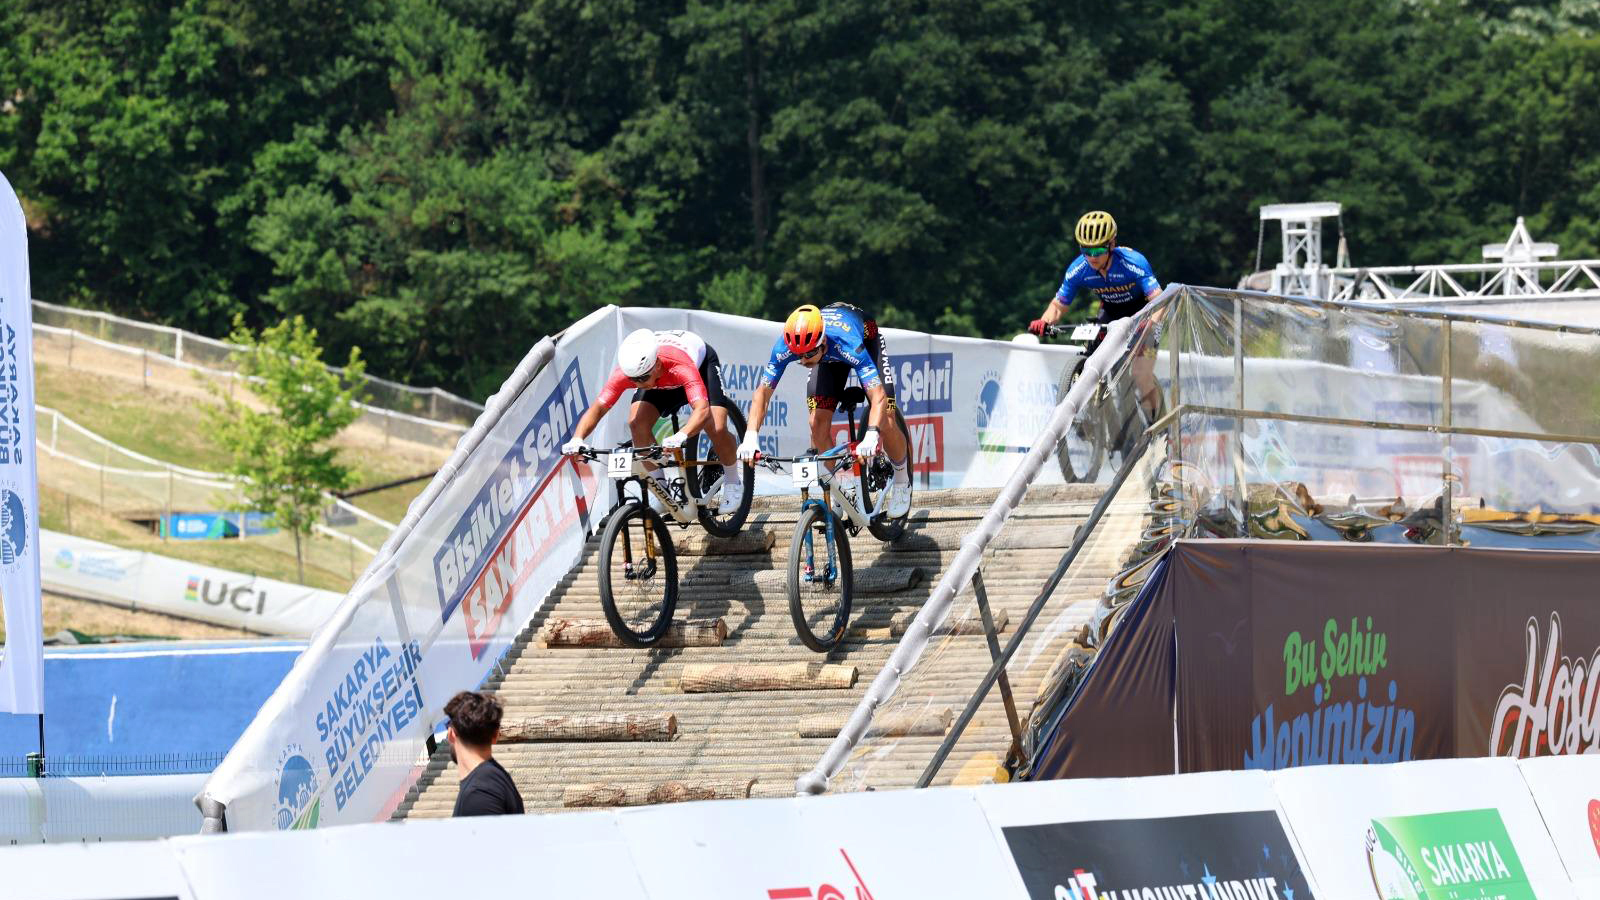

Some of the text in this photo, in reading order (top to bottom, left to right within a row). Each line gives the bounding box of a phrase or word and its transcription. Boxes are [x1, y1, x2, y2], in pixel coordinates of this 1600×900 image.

[834, 344, 860, 365] Auchan
[900, 360, 951, 412] Şehri
[439, 370, 586, 601] Bisiklet Şehri
[614, 457, 626, 469] 12
[801, 466, 809, 478] 5
[201, 579, 267, 615] UCI
[1283, 615, 1388, 701] Bu Şehir
[316, 636, 391, 742] SAKARYA
[325, 639, 423, 778] BÜYÜKŞEHİR
[333, 677, 424, 812] BELEDİYESİ
[1420, 840, 1512, 887] SAKARYA
